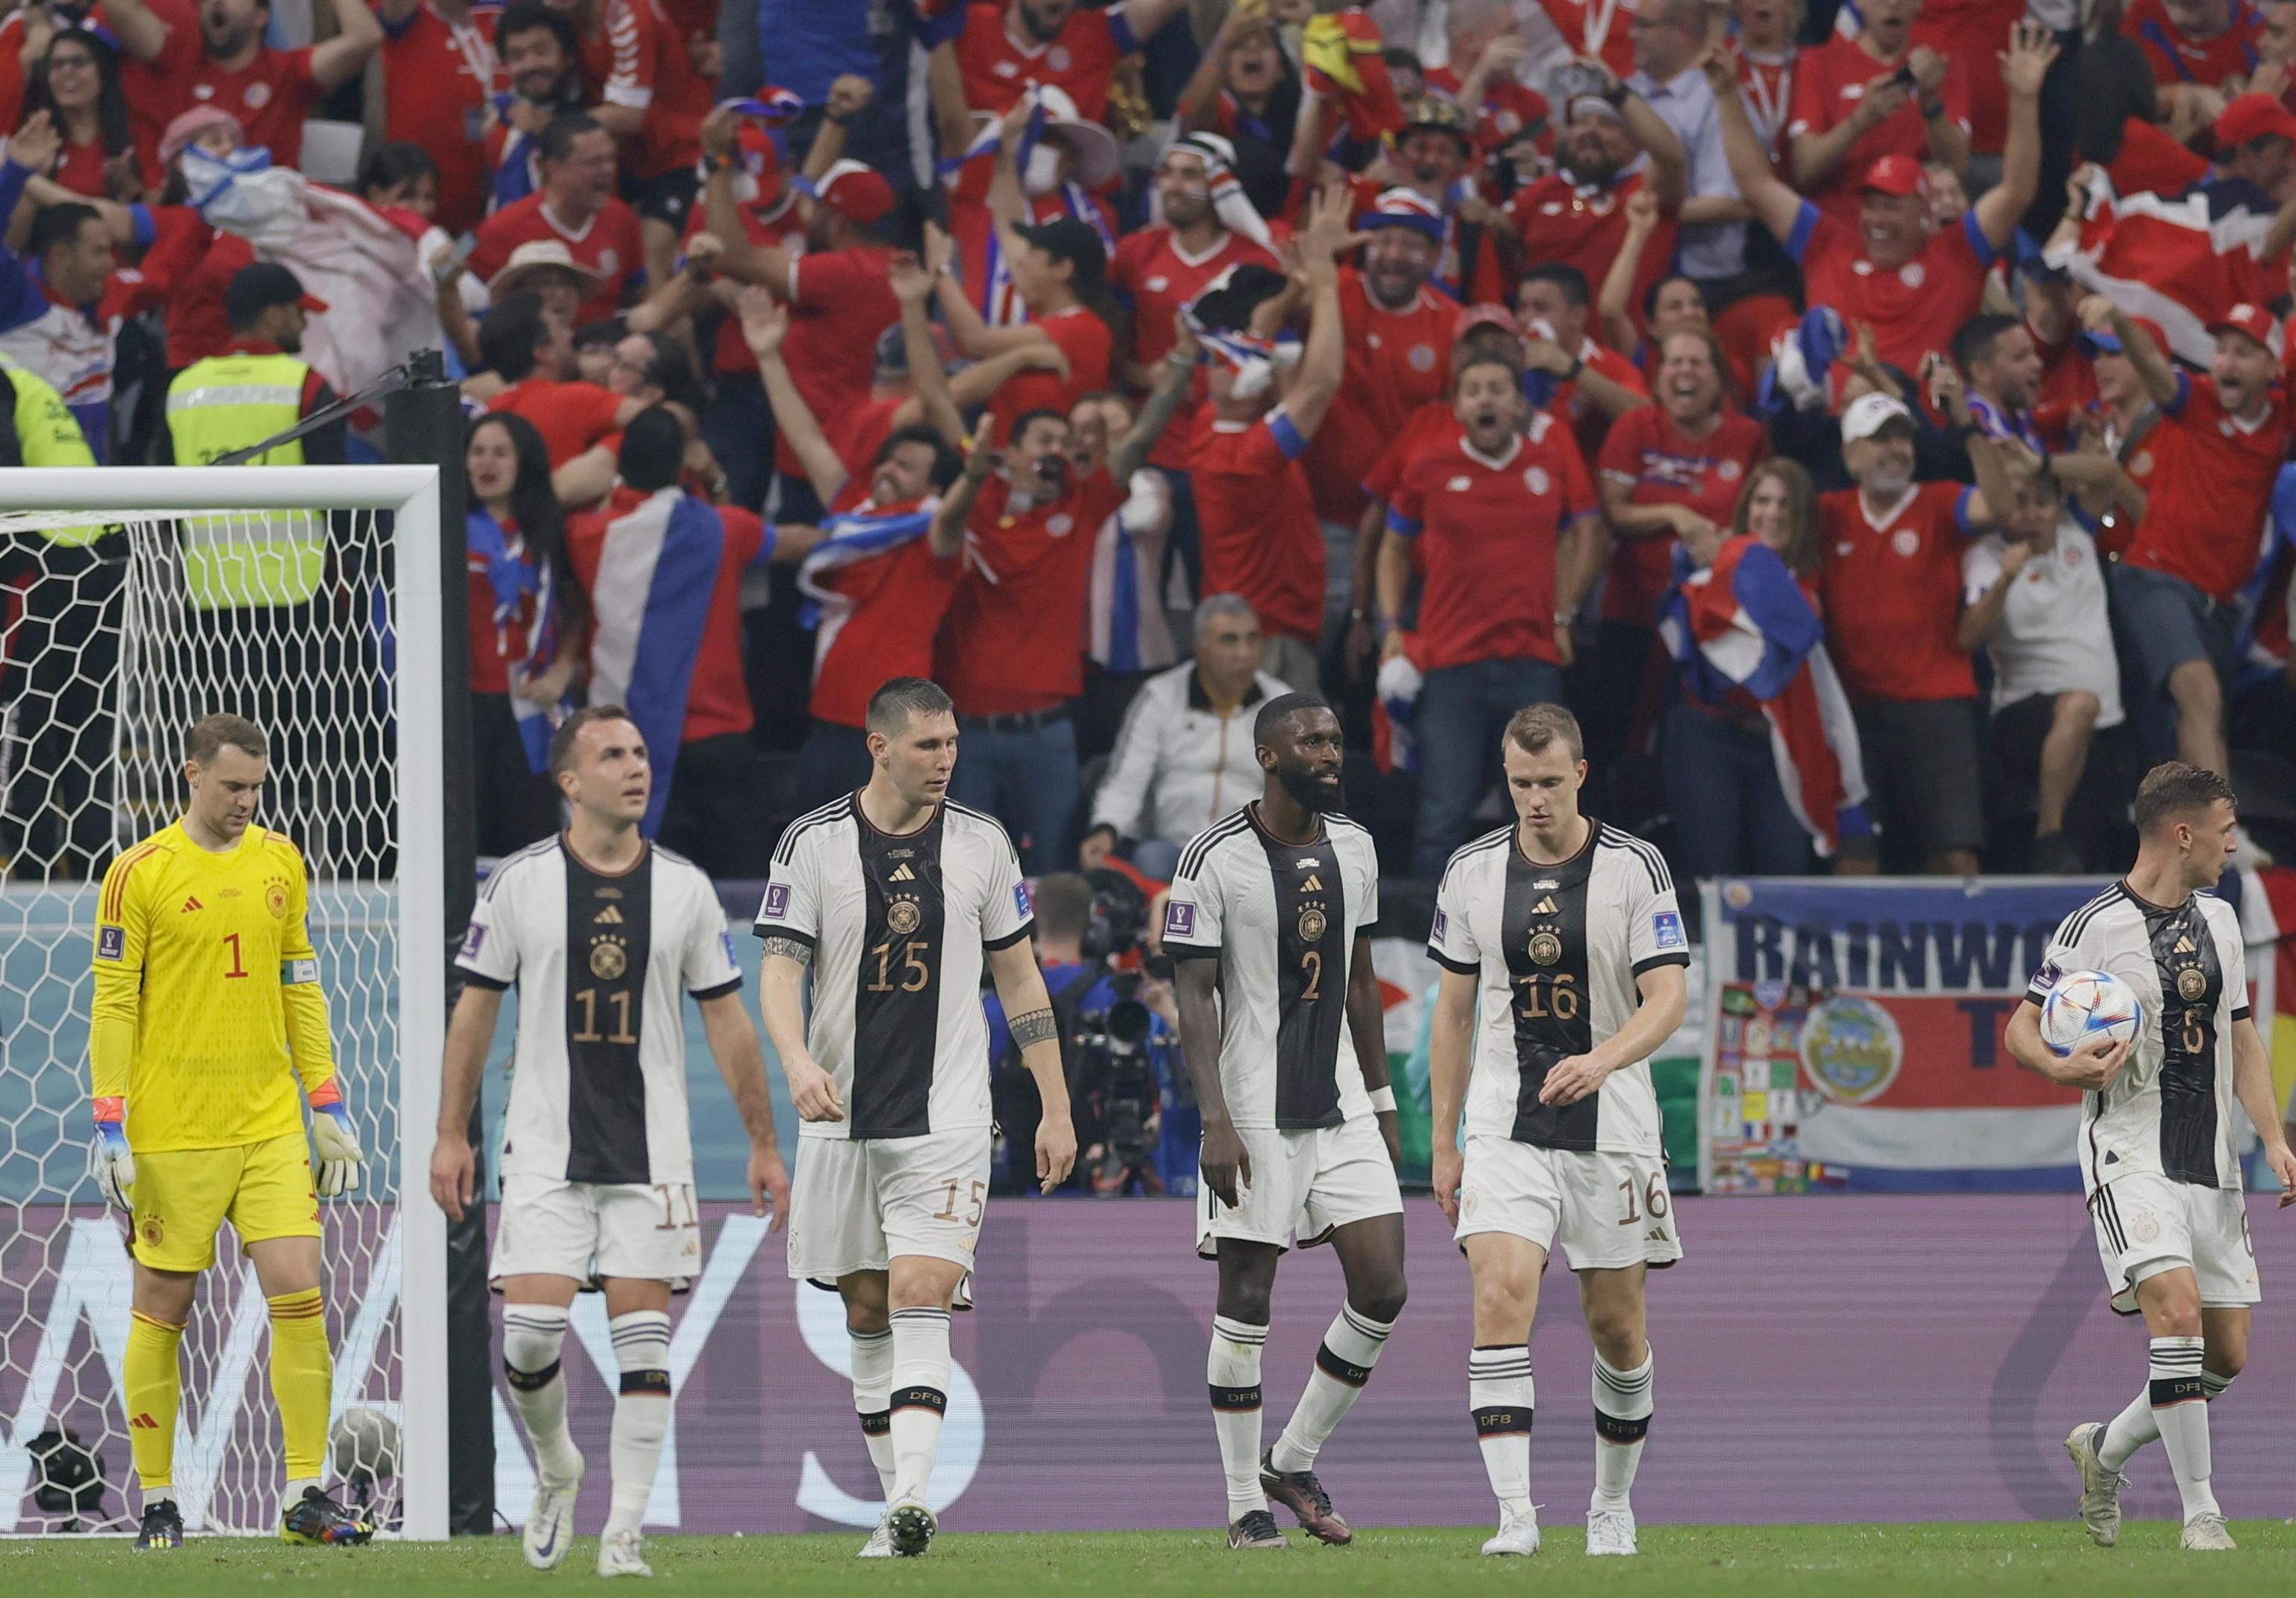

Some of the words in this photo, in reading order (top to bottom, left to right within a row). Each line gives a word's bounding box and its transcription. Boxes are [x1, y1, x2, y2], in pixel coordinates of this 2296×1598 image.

[223, 933, 248, 978] 1
[868, 942, 928, 991] 15
[1301, 951, 1321, 999] 2
[573, 987, 637, 1043] 11
[1519, 973, 1577, 1019] 16
[1955, 999, 2012, 1069] T
[2182, 1008, 2204, 1054] 6
[653, 1183, 700, 1230] 11
[933, 1177, 985, 1227] 15
[1619, 1171, 1667, 1225] 16
[910, 1392, 942, 1404] DFB
[1227, 1392, 1258, 1402] DFB
[2174, 1382, 2201, 1393] DFB
[1481, 1414, 1512, 1427] DFB
[1607, 1422, 1638, 1434] DFB
